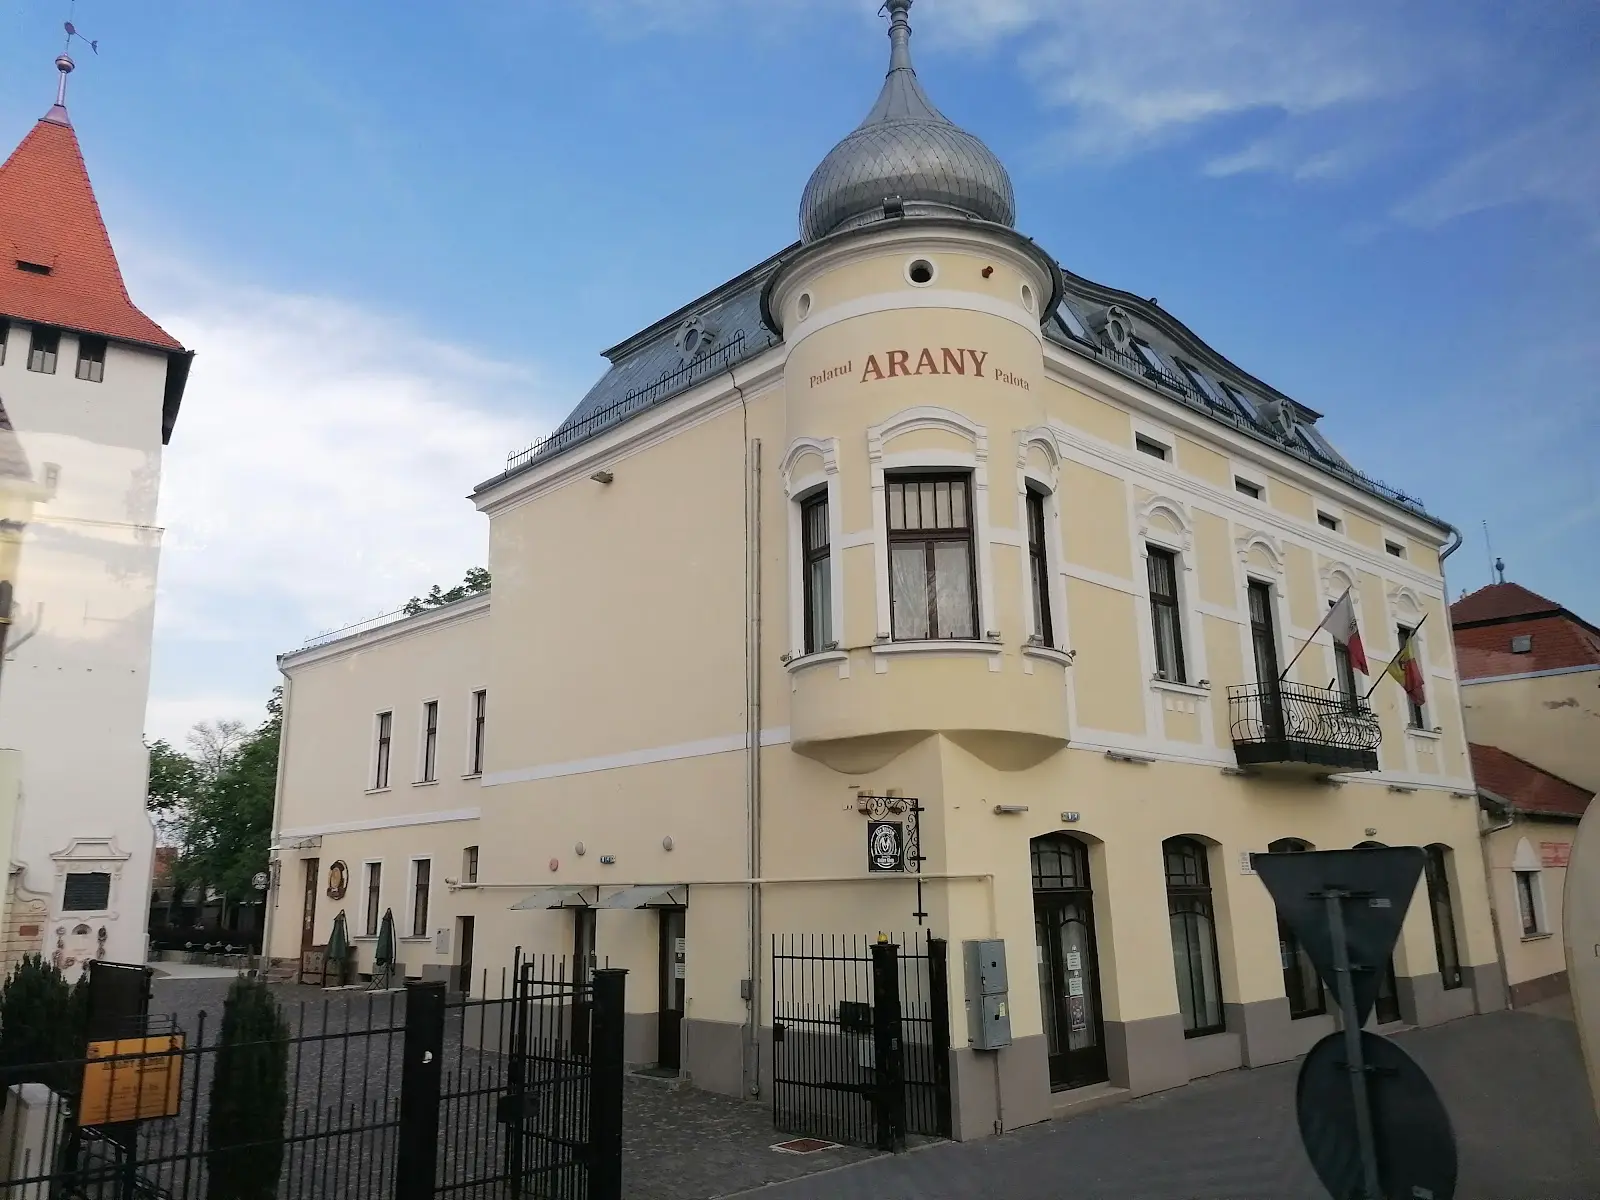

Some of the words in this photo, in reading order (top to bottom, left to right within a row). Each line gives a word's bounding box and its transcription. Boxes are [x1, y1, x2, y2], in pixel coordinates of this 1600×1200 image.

[809, 361, 852, 388] Palatul
[859, 347, 988, 384] ARANY
[994, 368, 1030, 391] Palota
